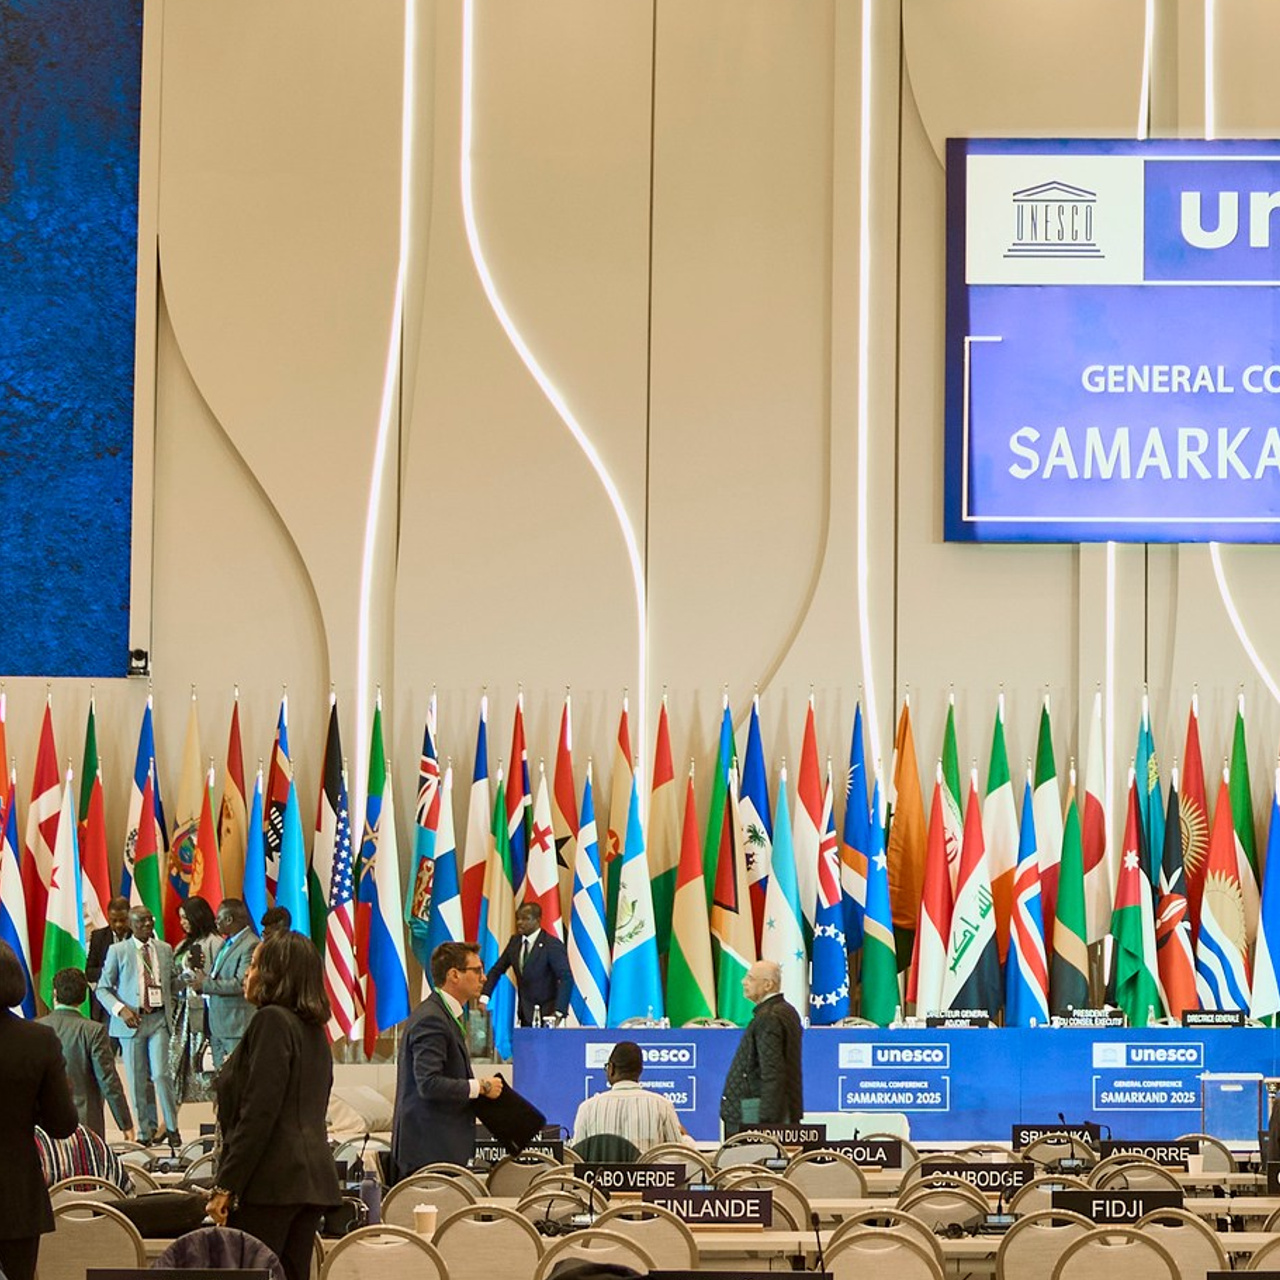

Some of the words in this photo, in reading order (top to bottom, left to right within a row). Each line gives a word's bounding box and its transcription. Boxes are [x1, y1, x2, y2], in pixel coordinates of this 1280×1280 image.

[1016, 204, 1093, 241] UNESCO
[1081, 364, 1235, 394] GENERAL
[877, 1048, 944, 1062] unesco
[1131, 1048, 1198, 1062] unesco
[859, 1080, 887, 1088] GENERAL
[888, 1080, 929, 1088] CONFERENCE
[1114, 1080, 1141, 1088] GENERAL
[1142, 1080, 1182, 1088] CONFERENCE
[847, 1092, 914, 1104] SAMARKAND
[916, 1092, 942, 1104] 2025
[1101, 1091, 1168, 1104] SAMARKAND
[1170, 1091, 1196, 1104] 2025
[784, 1129, 798, 1143] DU
[799, 1129, 819, 1143] SUD
[817, 1147, 887, 1161] ANGOLA
[1110, 1147, 1190, 1161] ANDORRE
[583, 1170, 624, 1188] CABO
[628, 1170, 675, 1188] VERDE
[932, 1170, 1024, 1187] CAMBODGE
[653, 1199, 760, 1217] FINLANDE
[1092, 1199, 1144, 1218] FIDJI
